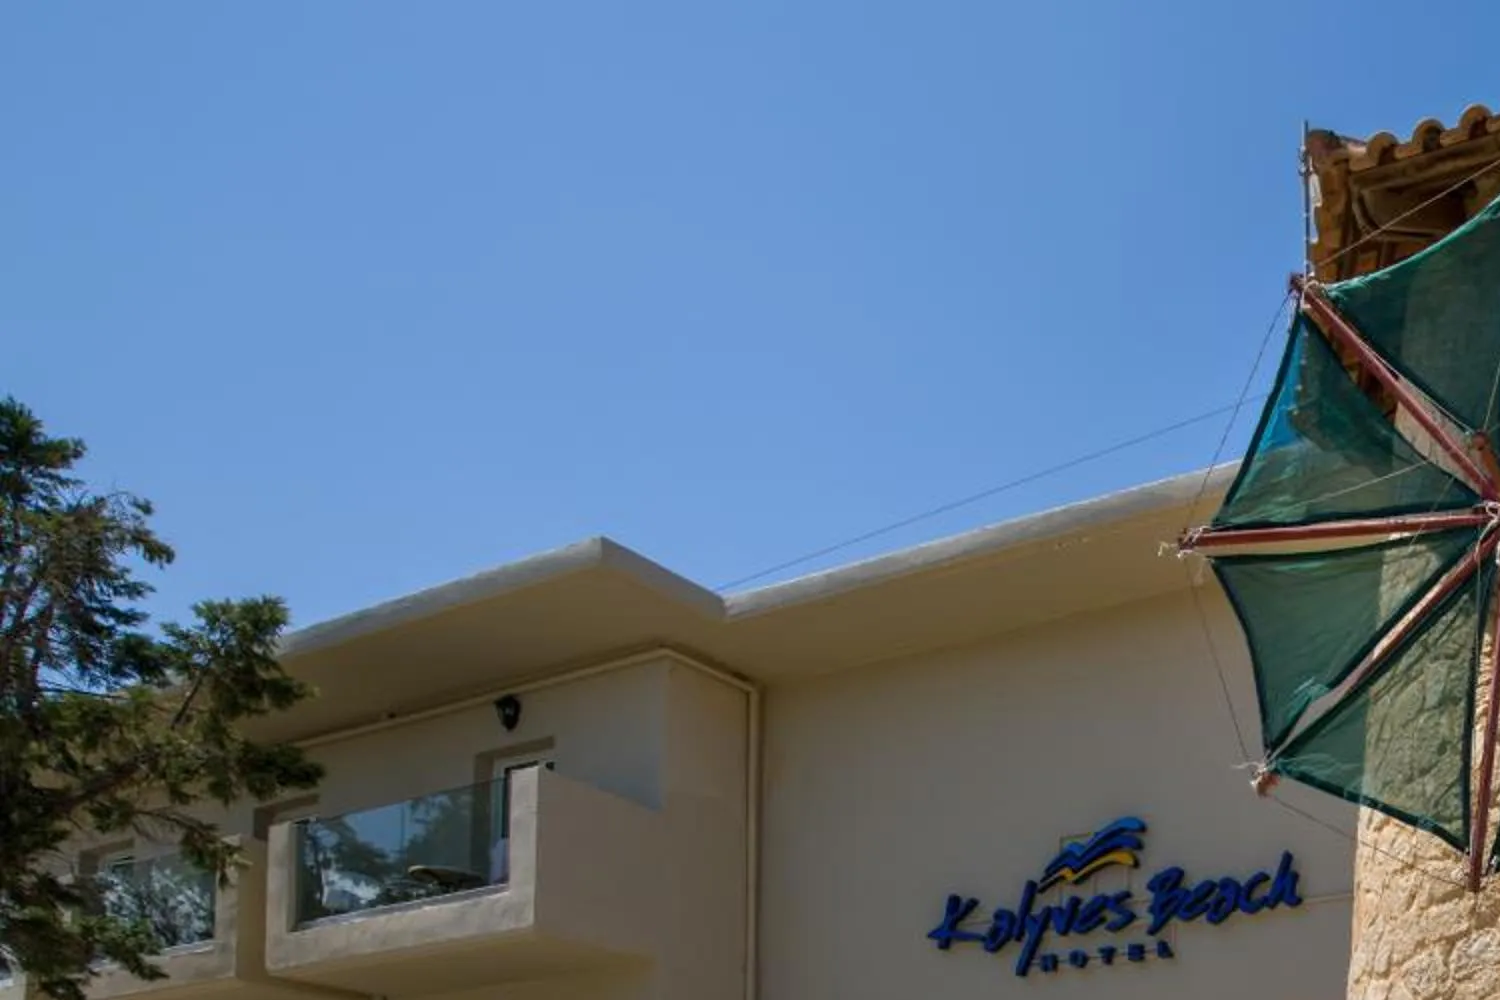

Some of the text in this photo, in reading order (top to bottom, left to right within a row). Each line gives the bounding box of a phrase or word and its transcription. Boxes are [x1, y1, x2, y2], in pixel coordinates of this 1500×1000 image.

[927, 849, 1303, 977] Kalyves Beach
[1040, 940, 1174, 973] HOTEL
